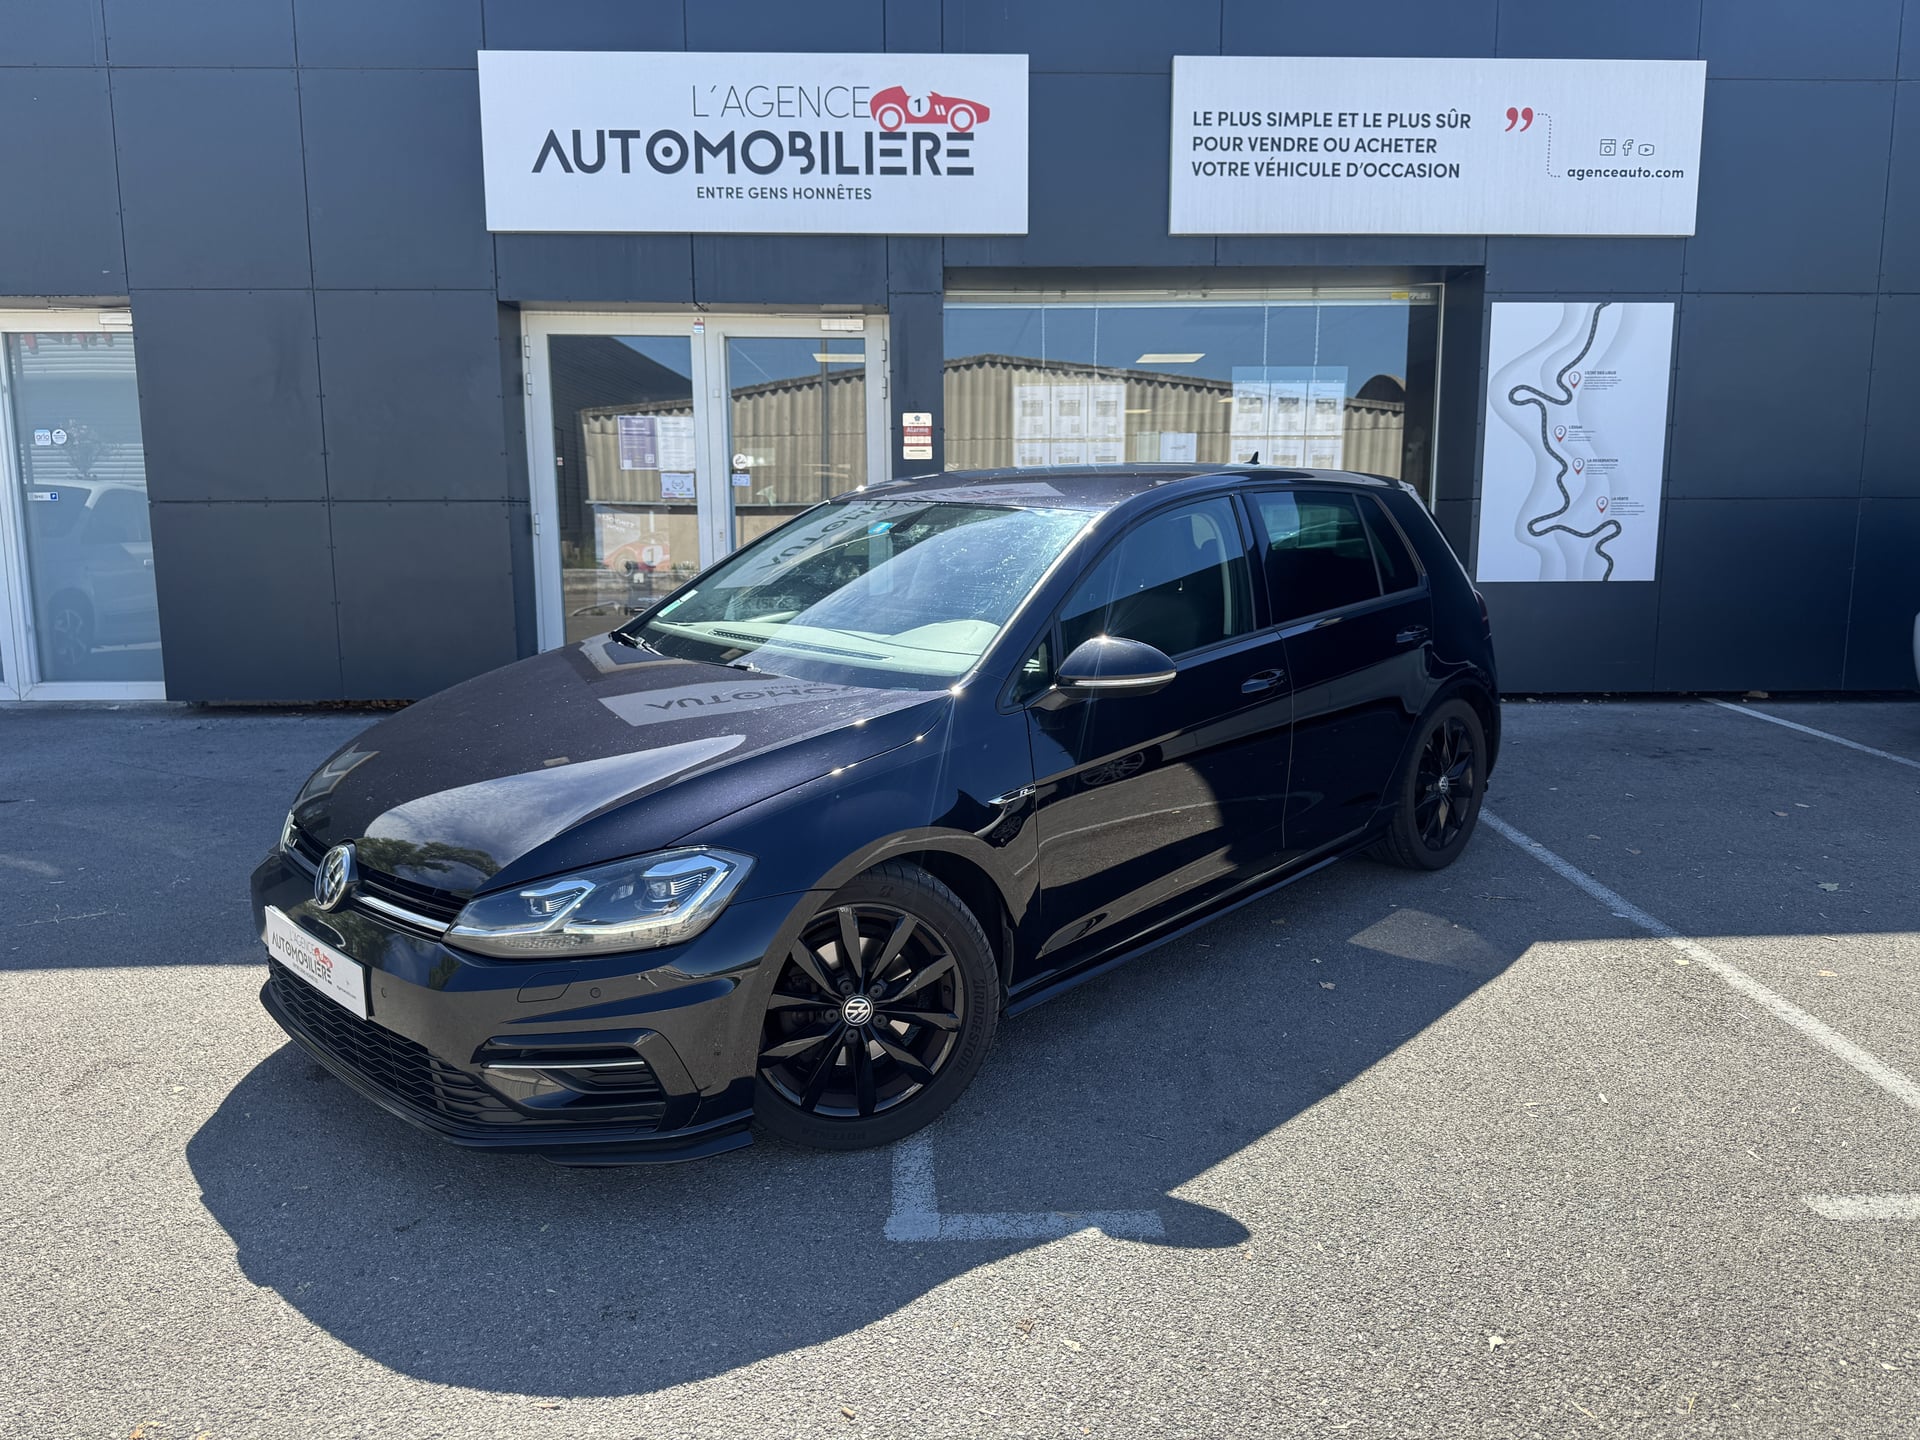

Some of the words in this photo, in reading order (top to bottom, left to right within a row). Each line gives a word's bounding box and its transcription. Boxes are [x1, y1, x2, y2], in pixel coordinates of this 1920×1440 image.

[692, 85, 871, 119] L'AGENCE
[914, 98, 922, 113] 1
[1192, 110, 1213, 127] LE
[1217, 111, 1263, 128] PLUS
[1266, 112, 1334, 128] SIMPLE
[1337, 113, 1360, 129] ET
[1362, 113, 1383, 129] LE
[1386, 113, 1432, 129] PLUS
[1435, 108, 1472, 129] SÛR
[1192, 136, 1244, 153] POUR
[1247, 137, 1320, 153] VENDRE
[1322, 137, 1351, 153] OU
[1353, 138, 1438, 154] ACHETER
[1192, 160, 1251, 177] VOTRE
[1253, 157, 1342, 178] VÉHICULE
[1567, 166, 1685, 182] agenceauto.com
[696, 186, 745, 199] ENTRE
[748, 187, 789, 199] GENS
[792, 184, 873, 201] HONNÊTES
